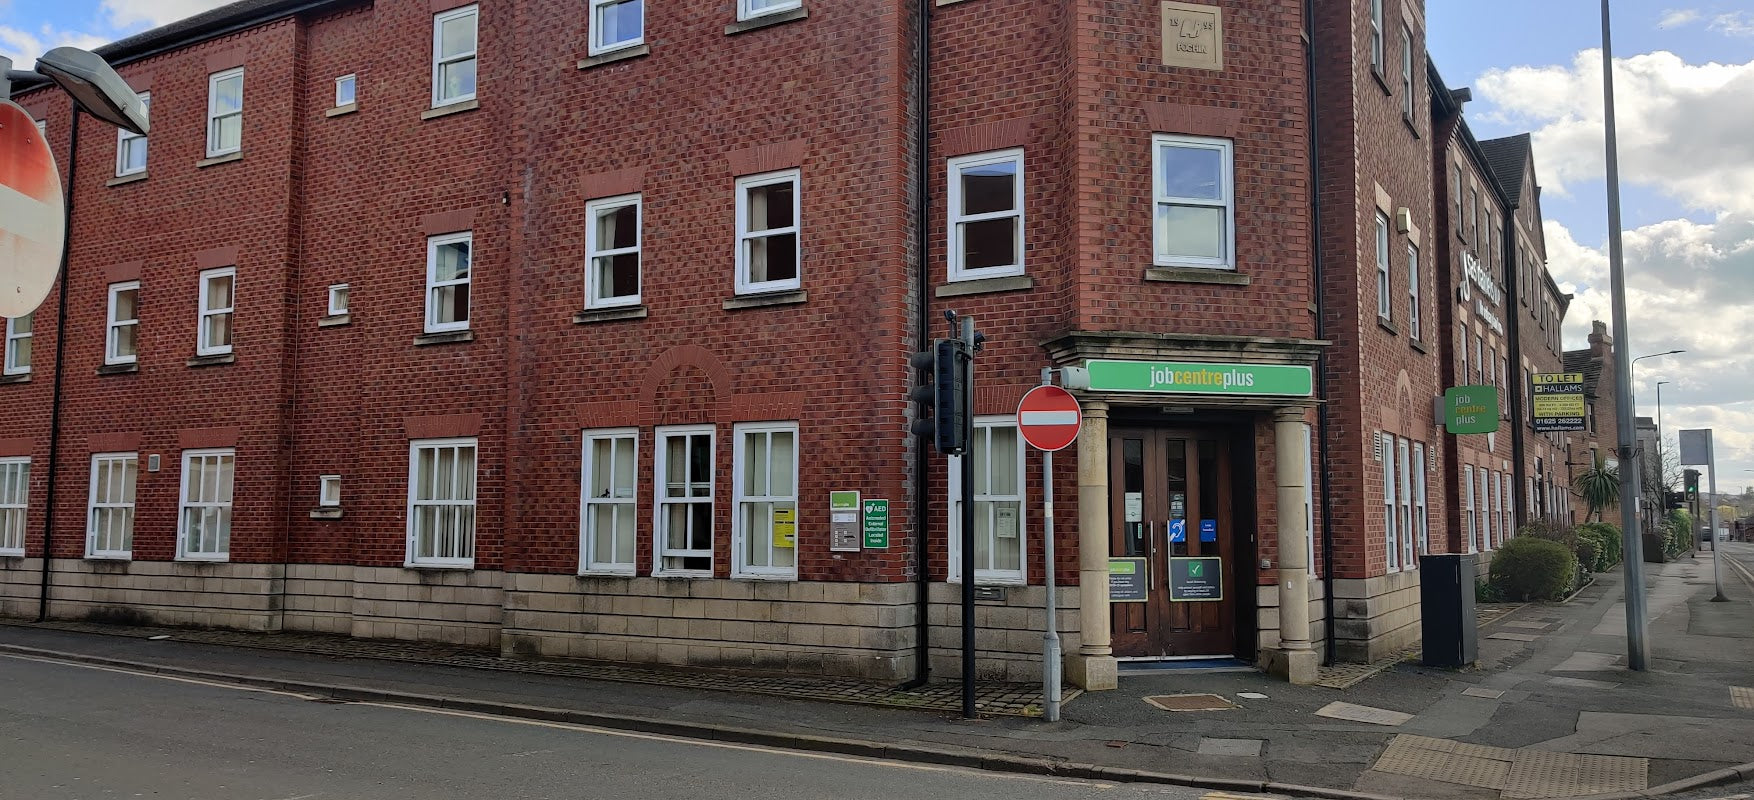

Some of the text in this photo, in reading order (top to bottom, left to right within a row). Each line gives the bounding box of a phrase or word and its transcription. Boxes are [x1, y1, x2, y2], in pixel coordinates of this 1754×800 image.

[1149, 366, 1254, 389] jobcentreplus
[1455, 394, 1471, 406] job
[1456, 405, 1486, 414] centre
[1456, 415, 1477, 426] plus
